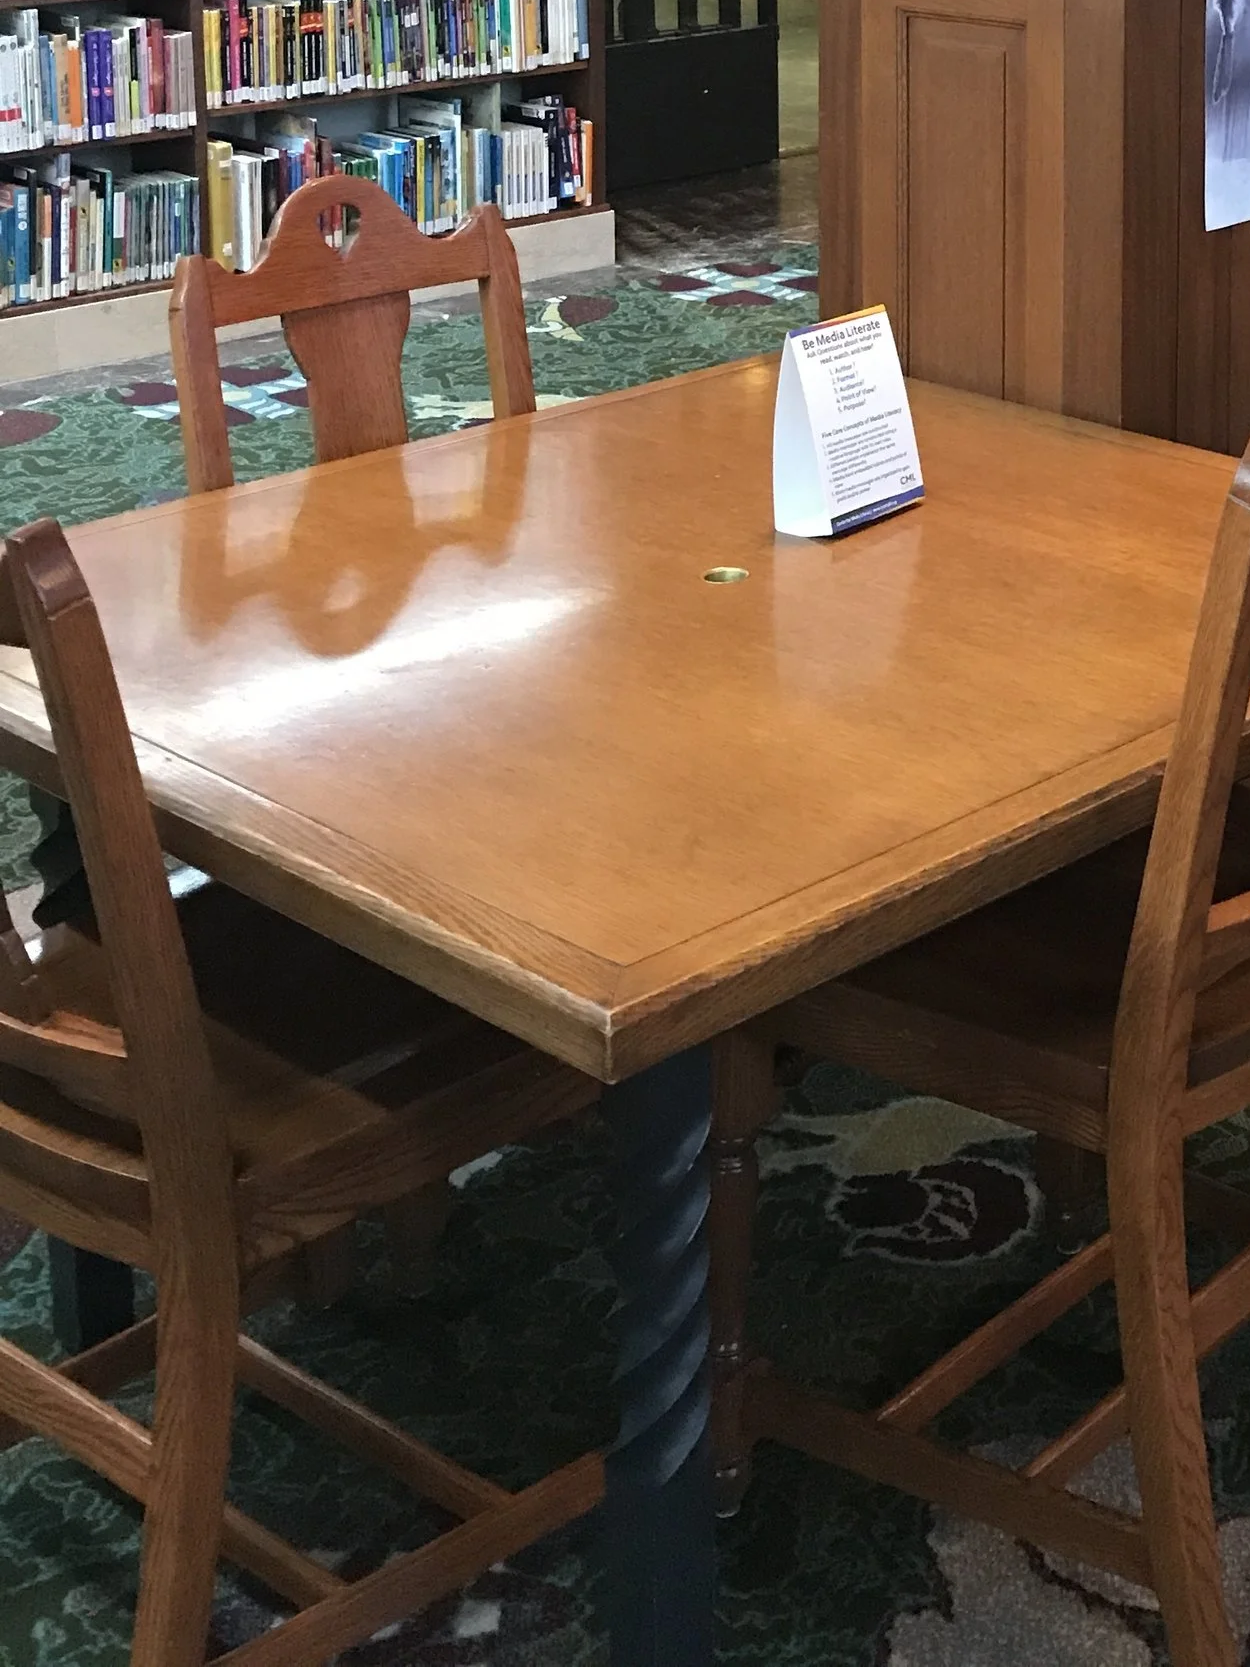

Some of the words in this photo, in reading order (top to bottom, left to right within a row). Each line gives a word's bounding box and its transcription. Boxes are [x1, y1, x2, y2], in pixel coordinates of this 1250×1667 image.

[801, 339, 815, 351] Be
[815, 330, 845, 346] Media
[845, 320, 881, 337] Literate
